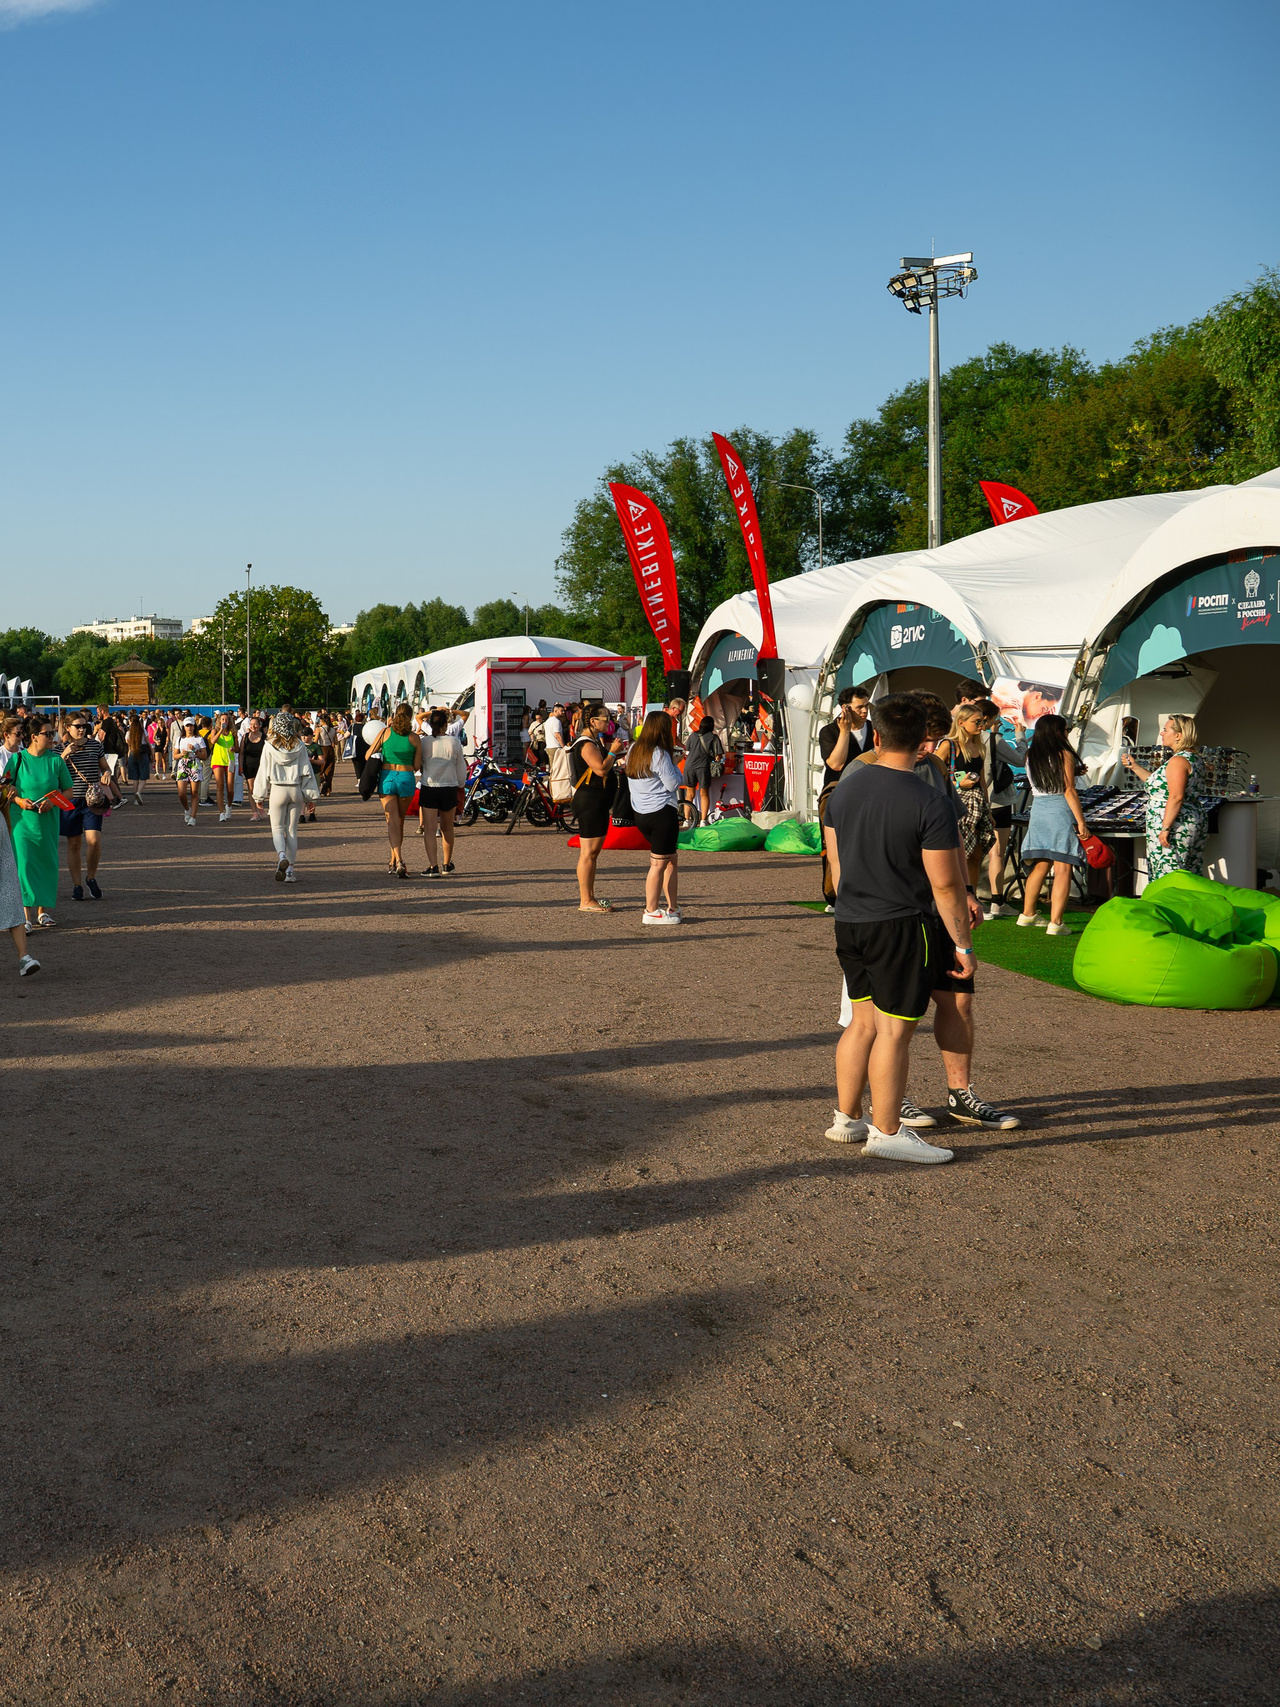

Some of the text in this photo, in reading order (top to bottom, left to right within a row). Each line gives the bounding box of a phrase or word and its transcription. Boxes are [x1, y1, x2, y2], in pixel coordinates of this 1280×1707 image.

[1198, 594, 1229, 608] РОСПП
[903, 624, 925, 643] 2ГИС
[745, 760, 769, 771] VELOCITY
